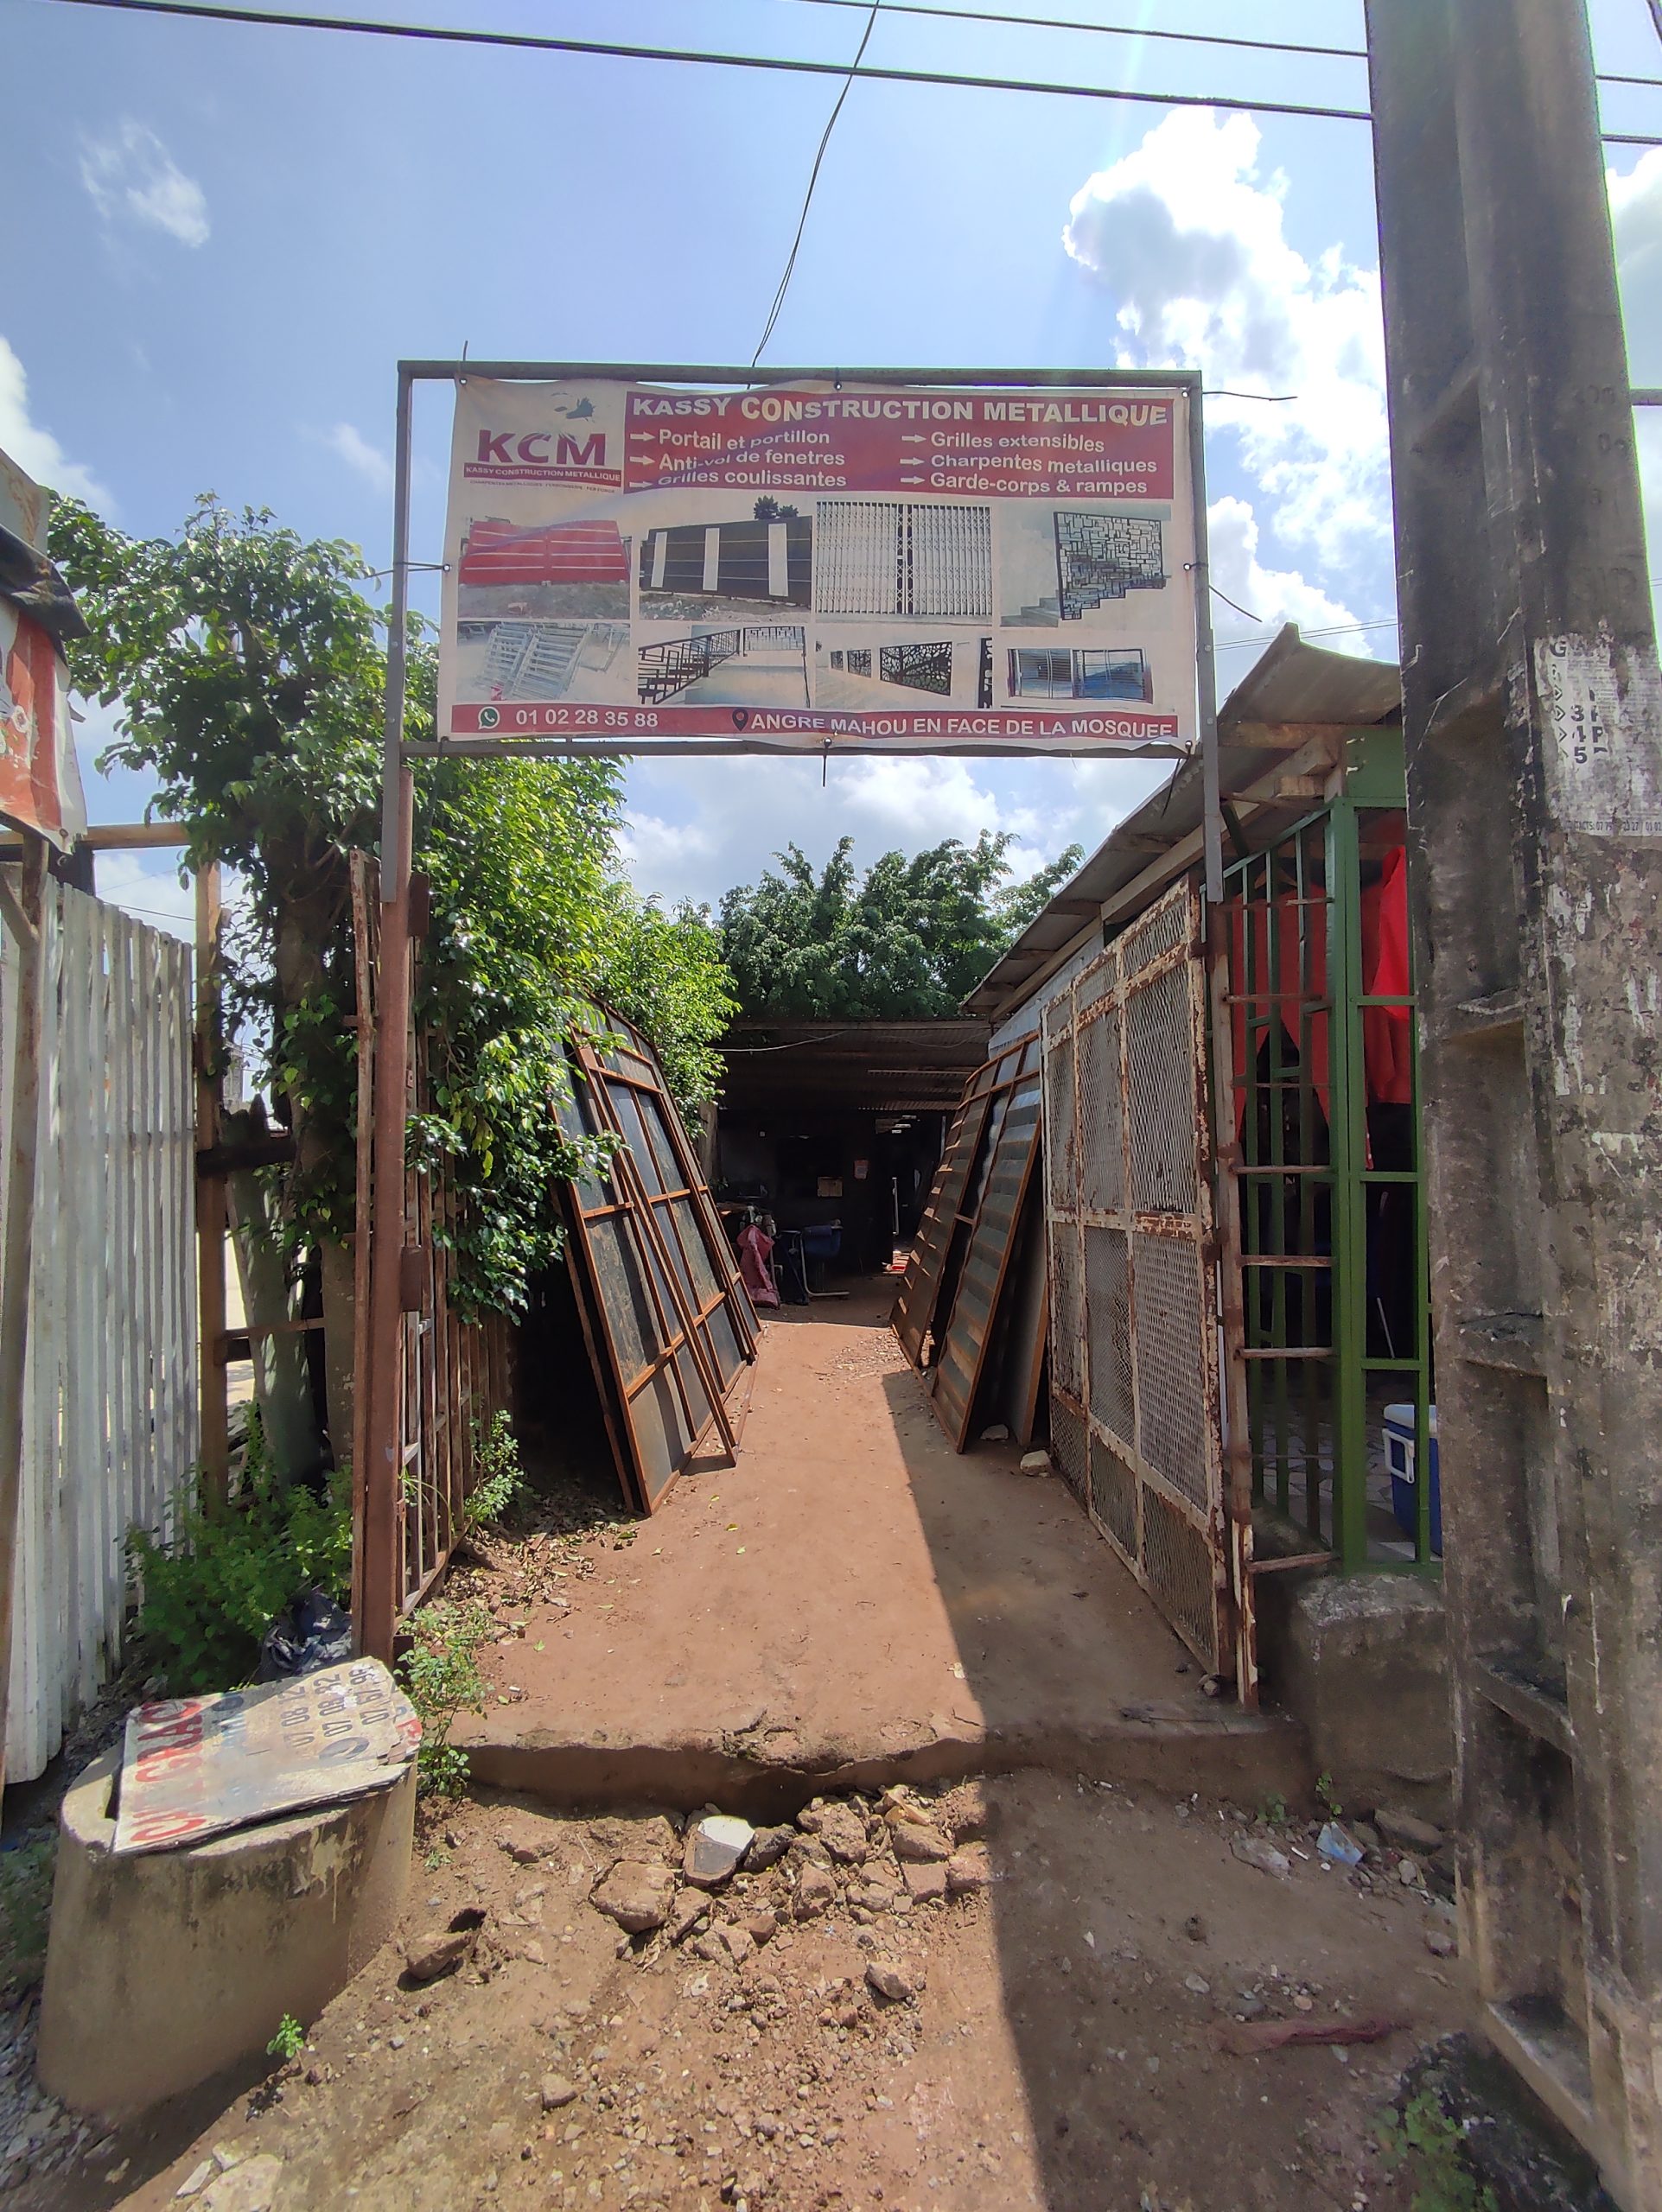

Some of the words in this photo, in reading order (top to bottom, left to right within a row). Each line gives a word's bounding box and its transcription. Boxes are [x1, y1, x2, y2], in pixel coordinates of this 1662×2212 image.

[633, 397, 732, 416] KASSY
[741, 397, 973, 422] CONSTRUCTION
[984, 401, 1168, 426] METALLIQUE
[477, 429, 607, 466] KCM
[659, 429, 722, 450] Portail
[726, 435, 746, 450] et
[750, 429, 831, 448] portillon
[931, 431, 993, 448] Grilles
[998, 434, 1105, 453] extensibles
[658, 453, 731, 471] Anti-vol
[735, 450, 761, 464] de
[765, 449, 846, 466] fenetres
[931, 454, 1043, 472] Charpentes
[1048, 458, 1158, 476] metalliques
[495, 468, 564, 477] CONSTRUCTION
[564, 471, 621, 481] METALLIQUE
[657, 470, 720, 486] Grilles
[724, 469, 847, 487] coulissantes
[930, 472, 1051, 496] Garde-corps
[1055, 480, 1072, 493] &
[1076, 480, 1148, 496] rampes
[516, 709, 538, 725] 01
[545, 709, 569, 725] 02
[575, 709, 598, 725] 28
[605, 711, 628, 727] 35
[634, 713, 658, 728] 88
[751, 714, 825, 729] ANGRE
[831, 718, 907, 735] MAHOU
[914, 718, 940, 733] EN
[947, 718, 1000, 734] FACE
[1006, 719, 1033, 735] DE
[1040, 721, 1066, 735] LA
[1072, 719, 1172, 738] MOSQUEE
[280, 1707, 310, 1726] 08
[360, 1708, 389, 1725] 07
[322, 1720, 353, 1737] 07
